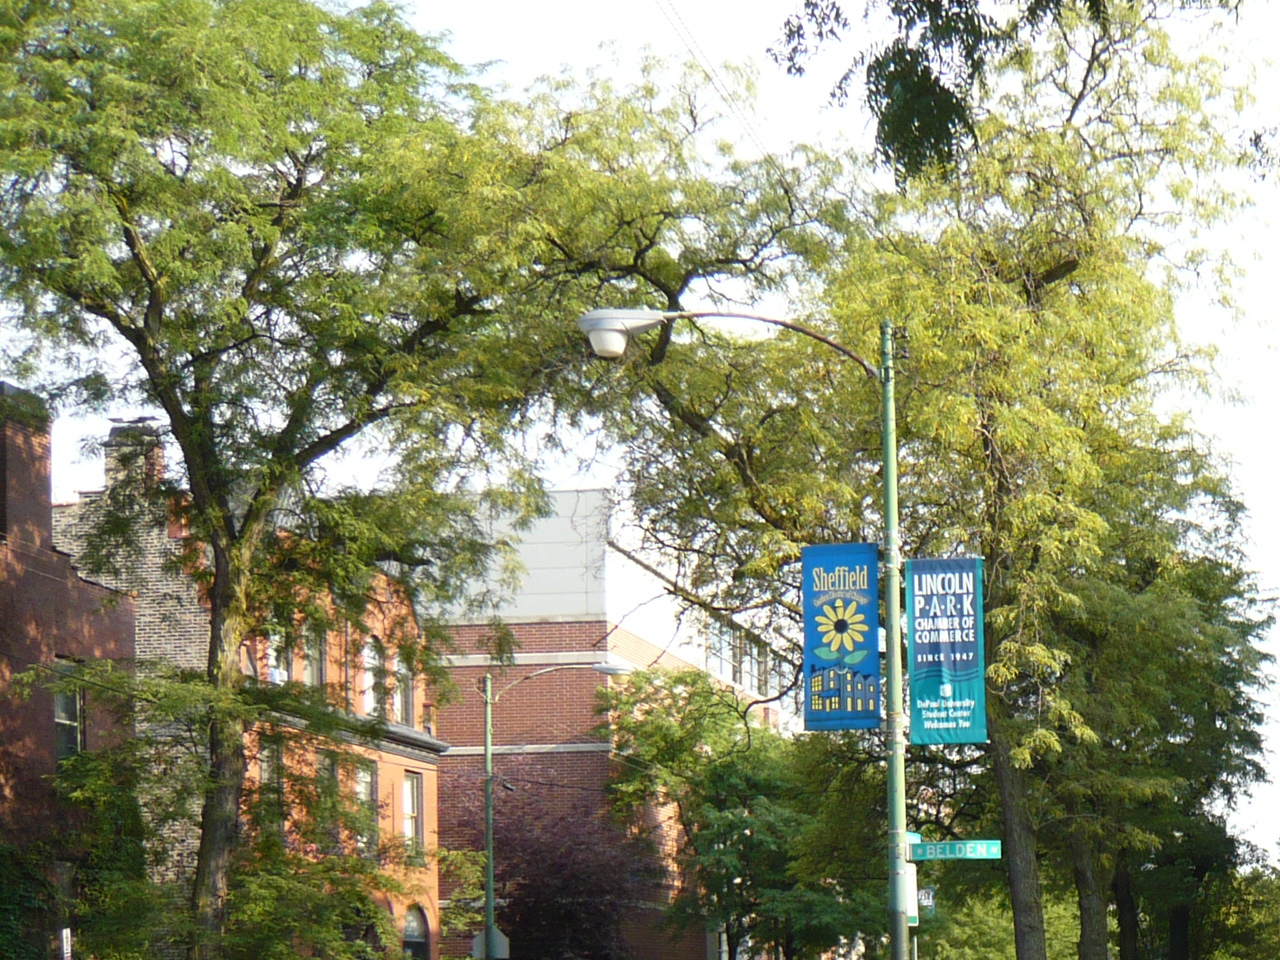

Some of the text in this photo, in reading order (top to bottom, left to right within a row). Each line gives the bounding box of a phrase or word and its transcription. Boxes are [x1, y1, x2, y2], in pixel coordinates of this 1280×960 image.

[813, 565, 868, 591] Sheffield
[914, 572, 974, 595] LINCOLN
[915, 616, 975, 630] CHAMBER OF
[915, 629, 975, 644] COMMERCE
[917, 652, 974, 662] SINCE 1947
[917, 698, 976, 709] DePaul University
[922, 708, 971, 719] Student Center
[924, 718, 971, 729] Welcomes You
[926, 843, 987, 858] BELDEN
